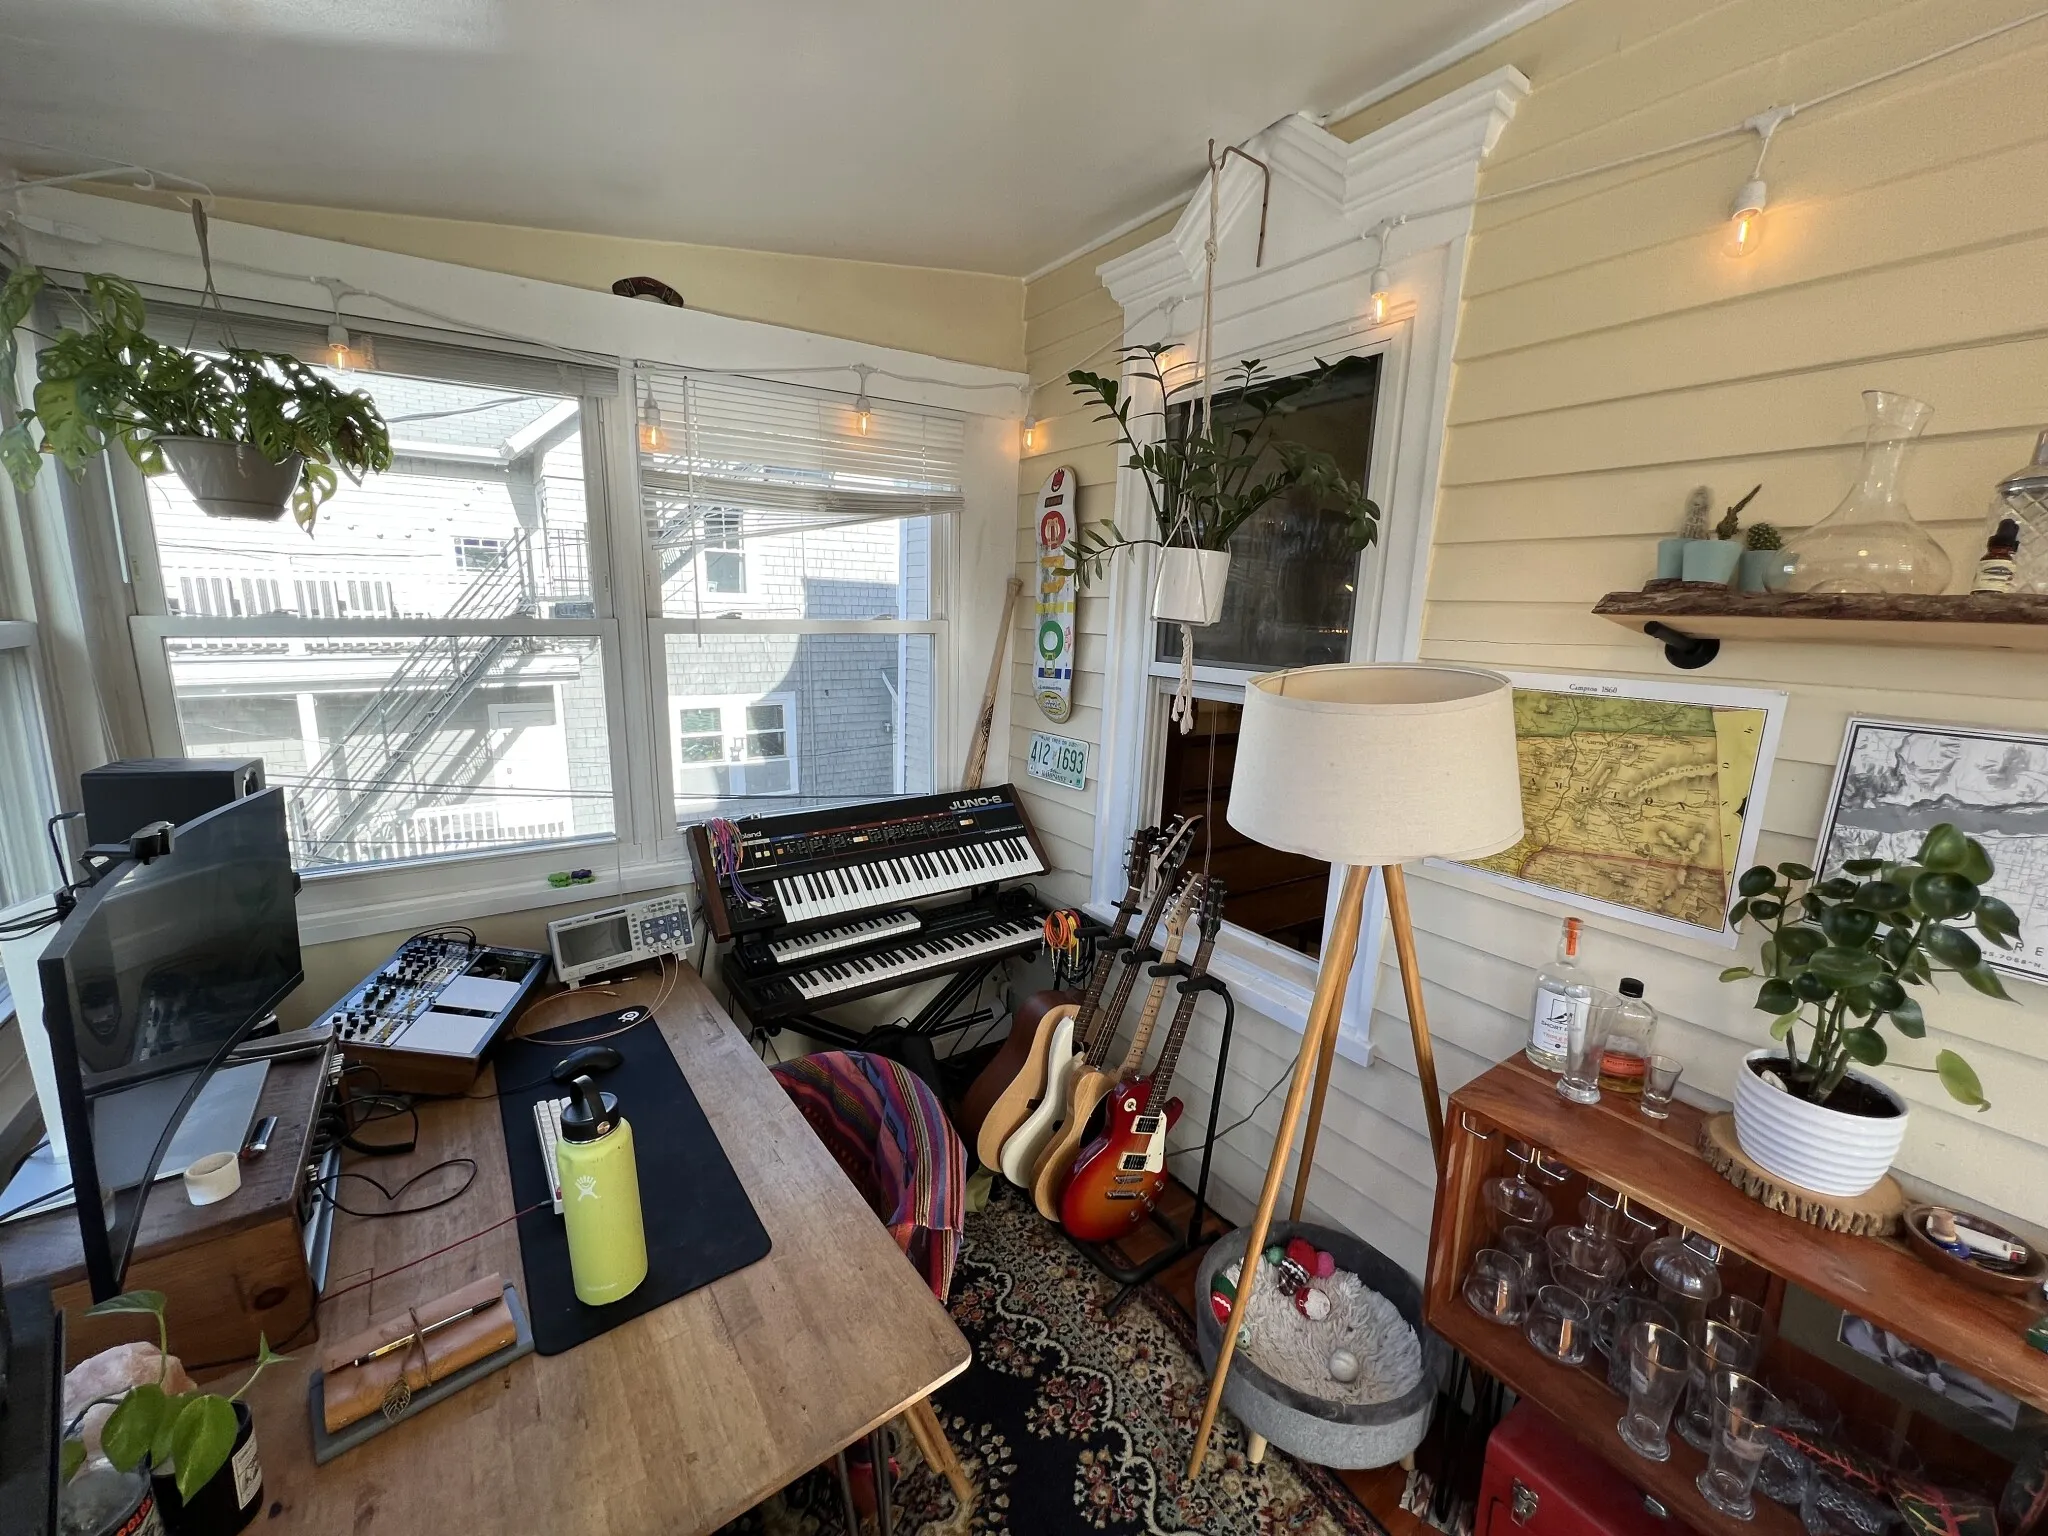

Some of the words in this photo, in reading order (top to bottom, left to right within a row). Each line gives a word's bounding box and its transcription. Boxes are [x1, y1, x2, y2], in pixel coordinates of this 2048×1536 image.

[1569, 683, 1598, 693] Campton
[1601, 686, 1618, 694] 1860
[1030, 740, 1051, 765] 412
[1056, 746, 1084, 775] 1693
[948, 795, 1003, 811] JUNO-6
[741, 831, 762, 840] oland
[1540, 1020, 1563, 1031] SHORT
